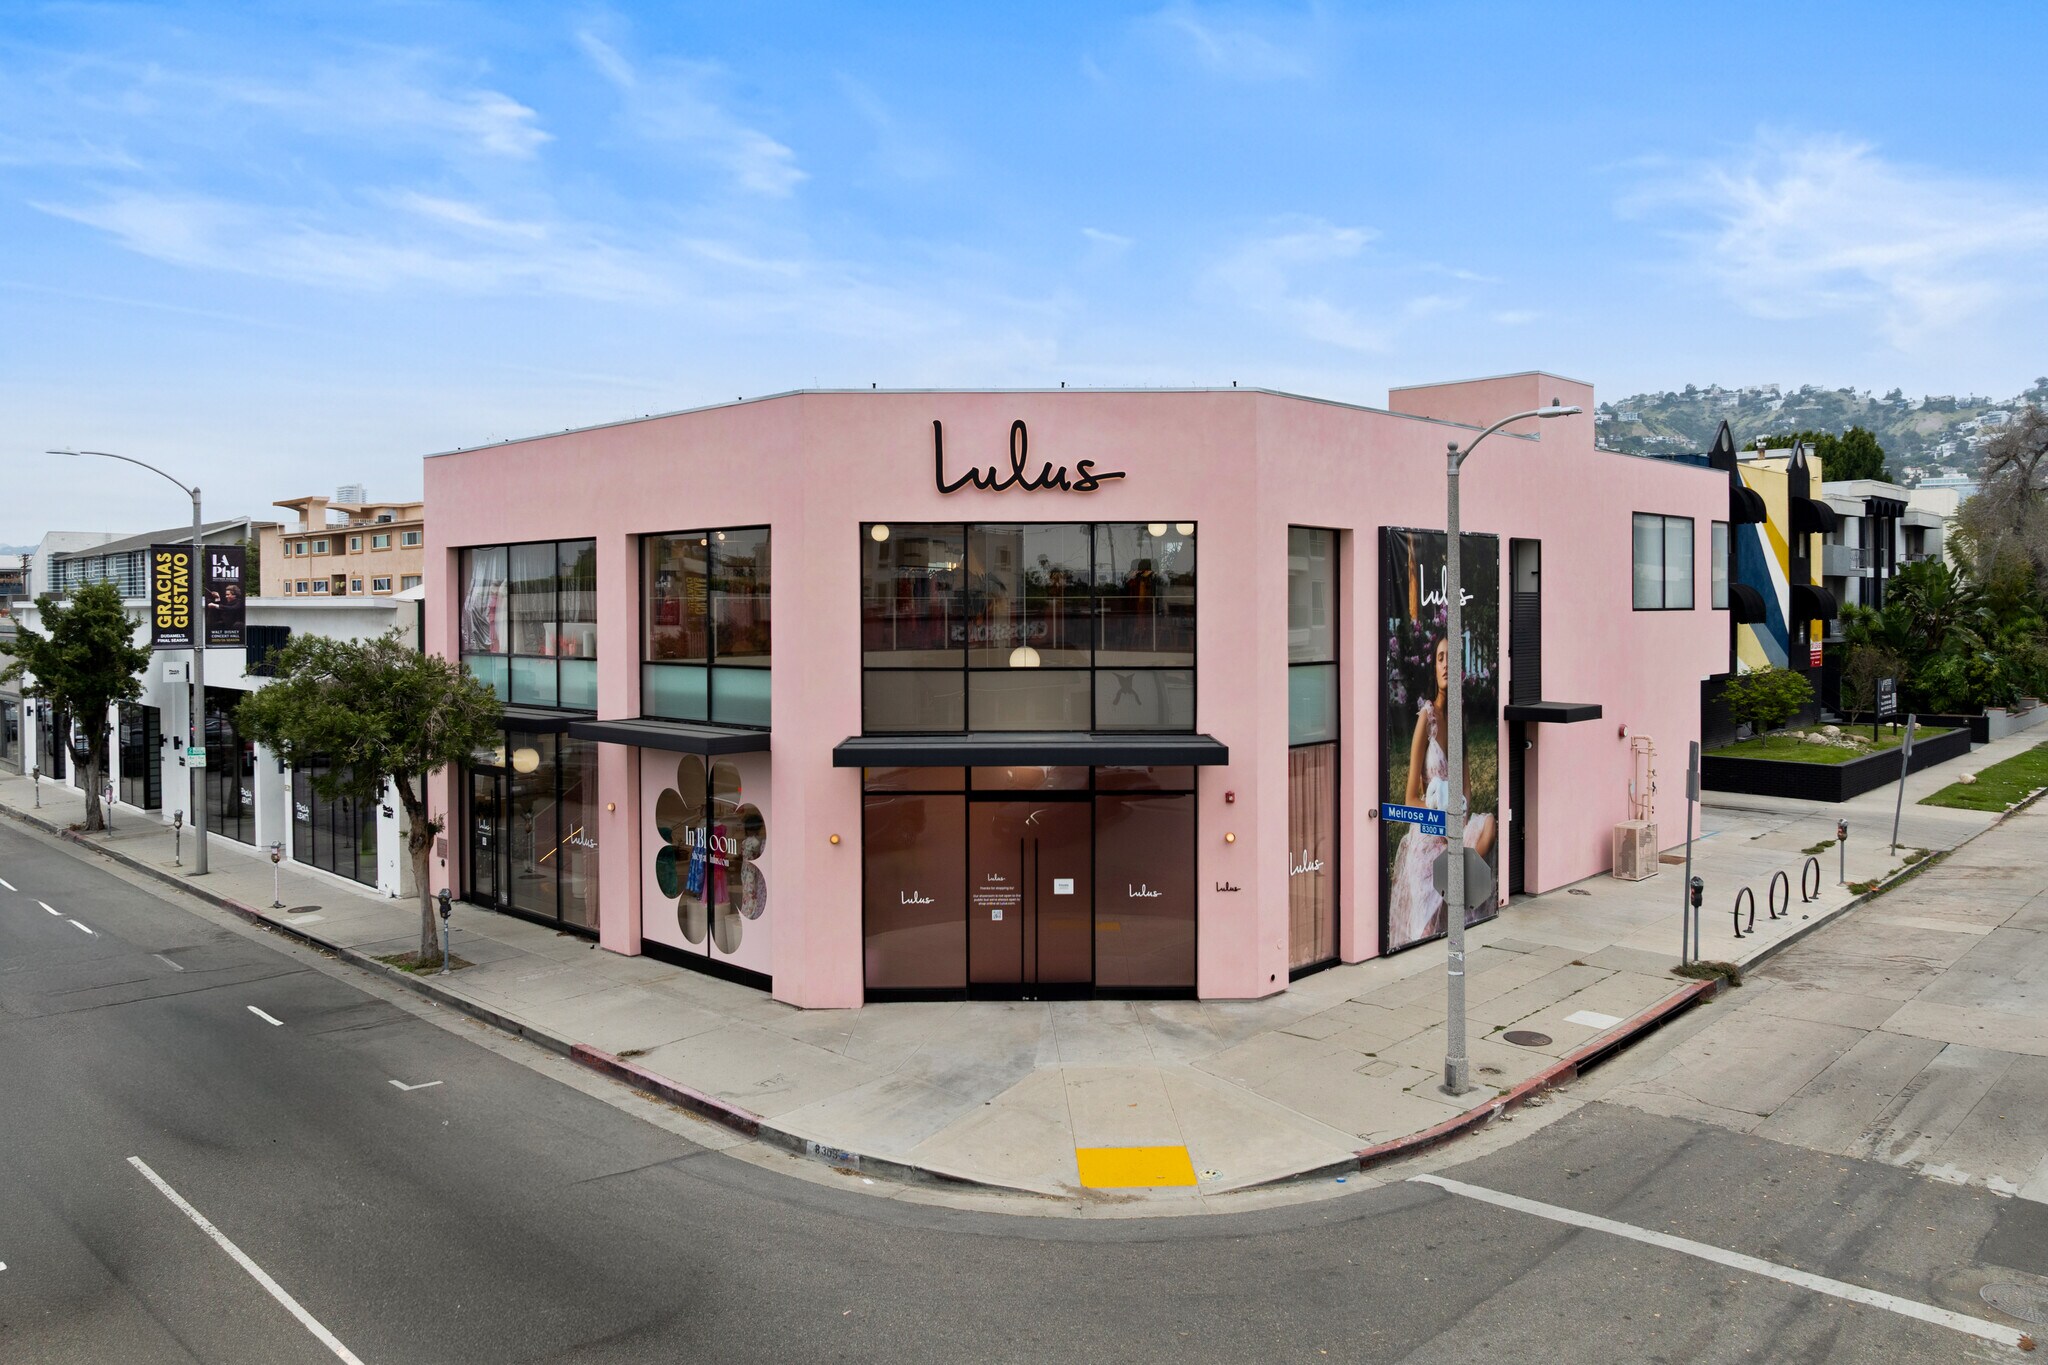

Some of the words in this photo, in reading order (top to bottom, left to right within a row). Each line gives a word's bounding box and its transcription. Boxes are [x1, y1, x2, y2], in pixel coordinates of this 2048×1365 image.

[932, 419, 1126, 494] Lulus
[212, 553, 229, 566] LA
[212, 565, 239, 578] Phil
[156, 552, 172, 629] GRACIAS
[173, 553, 189, 629] GUSTAVO
[1420, 563, 1474, 606] Luls
[1388, 806, 1424, 821] Melrose
[1427, 811, 1439, 823] Av
[1421, 824, 1437, 834] 8300
[1438, 827, 1444, 835] W
[685, 825, 695, 847] In
[697, 826, 737, 855] Bloom
[1289, 849, 1324, 876] Lulus
[1129, 883, 1162, 898] Lulus
[1215, 881, 1241, 893] Lulus
[901, 890, 935, 905] Lulus
